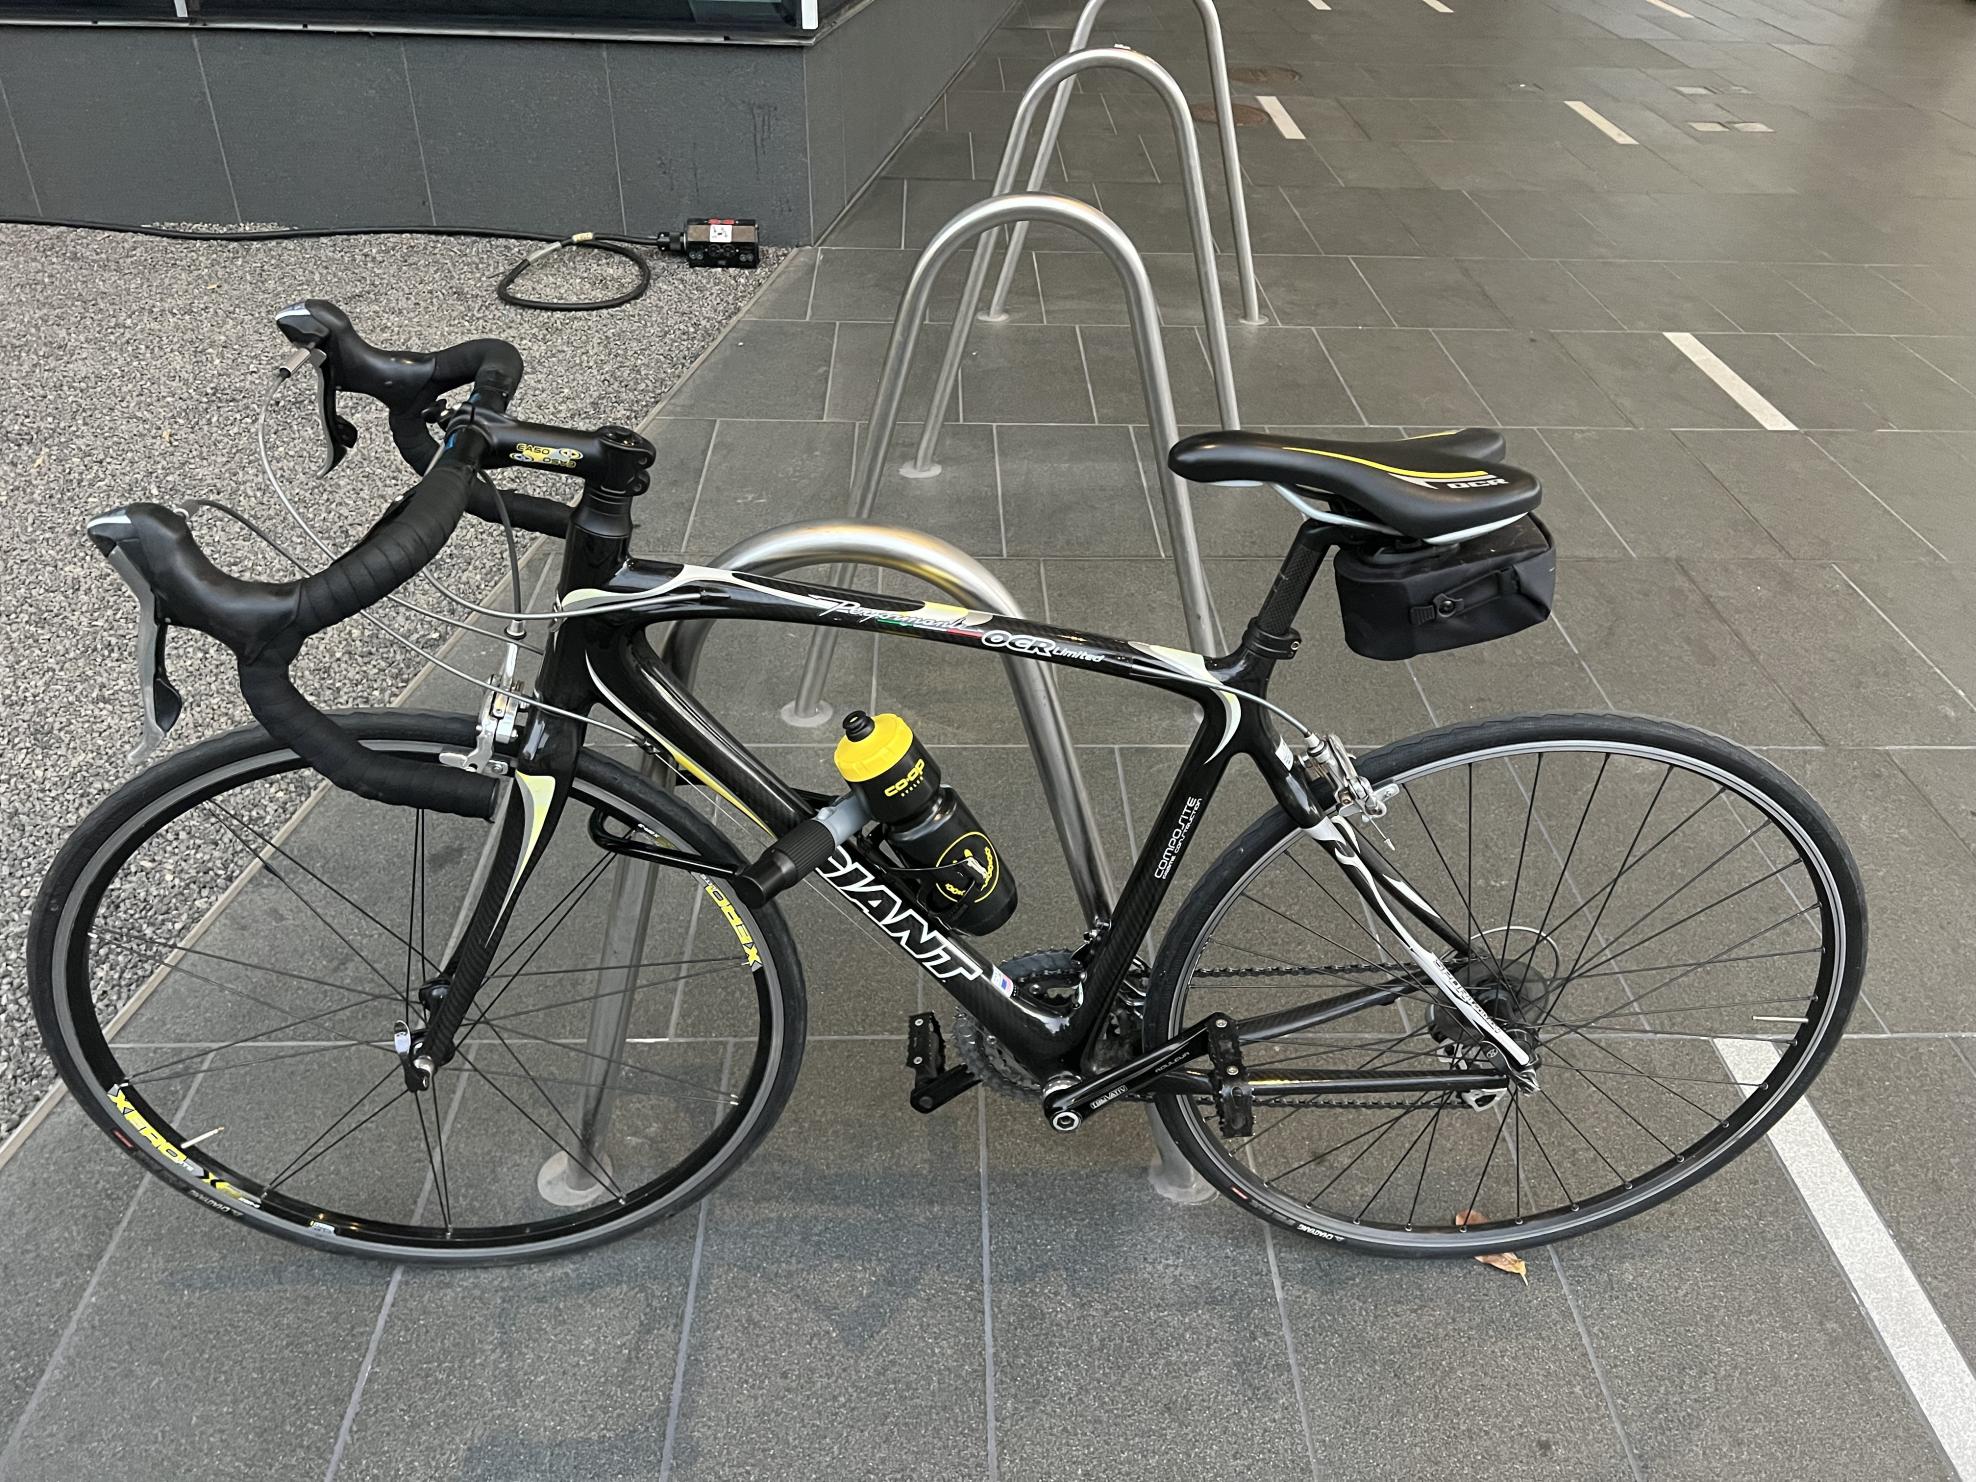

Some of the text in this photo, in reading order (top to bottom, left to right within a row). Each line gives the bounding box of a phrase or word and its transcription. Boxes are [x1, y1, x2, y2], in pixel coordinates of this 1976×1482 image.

[1446, 478, 1510, 489] OCR
[981, 630, 1105, 662] OCR Limited
[1154, 796, 1197, 878] COMPOSITE
